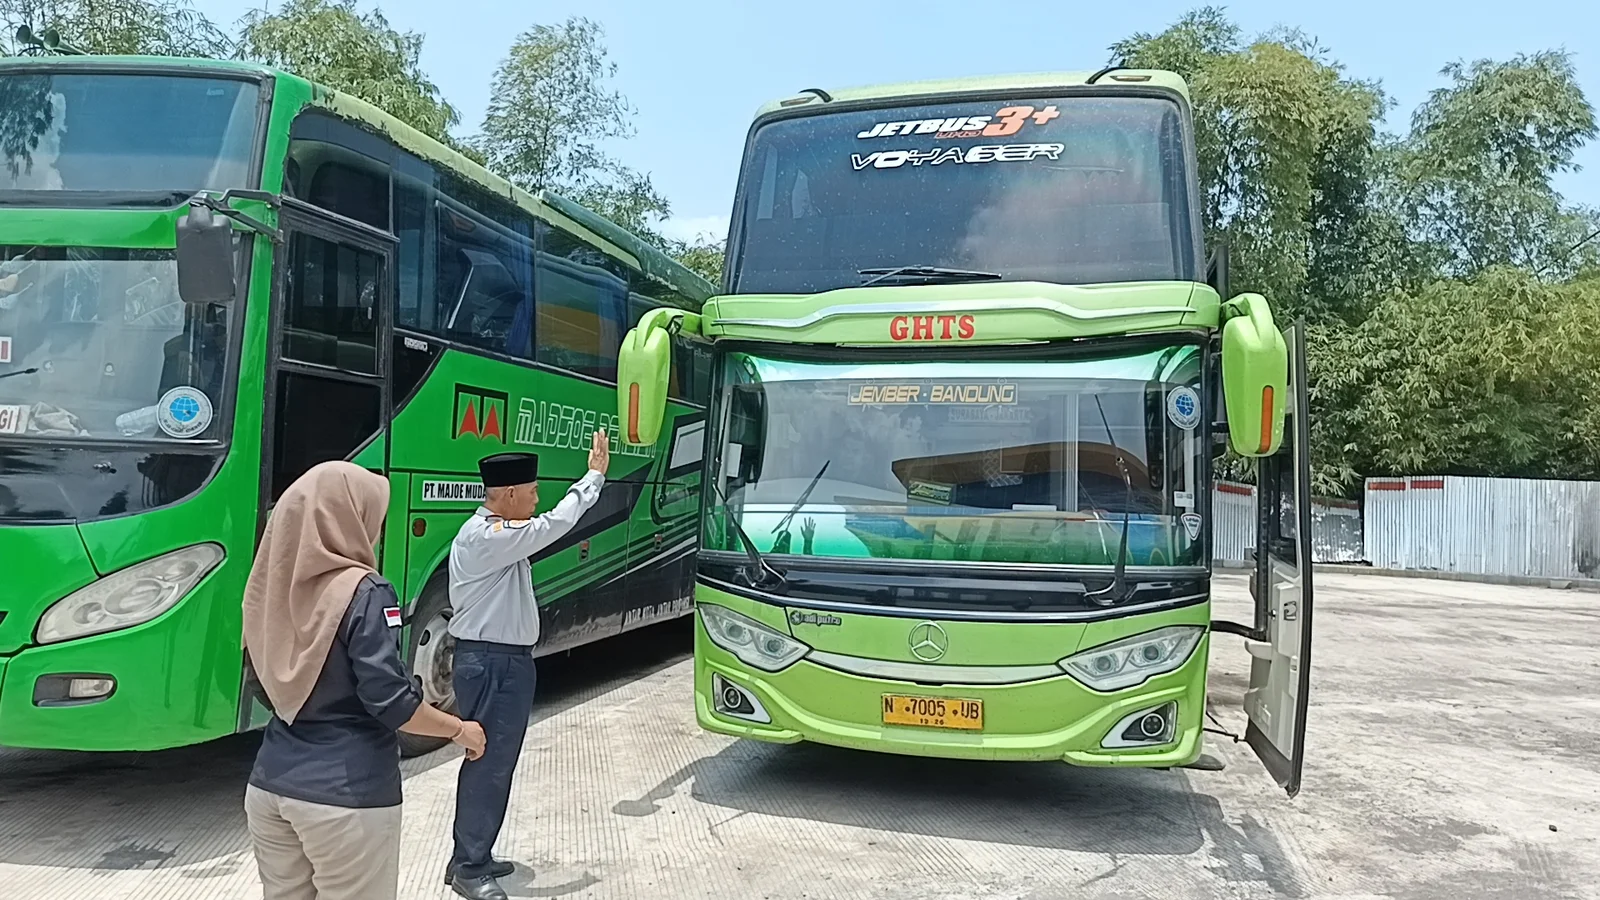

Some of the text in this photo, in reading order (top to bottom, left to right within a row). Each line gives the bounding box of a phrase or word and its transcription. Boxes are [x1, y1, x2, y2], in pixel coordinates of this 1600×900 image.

[890, 314, 975, 341] GHTS
[850, 385, 1015, 403] JEMBER BANDUNG
[424, 482, 436, 498] PT.
[437, 483, 464, 499] MAJOE
[884, 697, 894, 713] N
[910, 698, 946, 717] 7005
